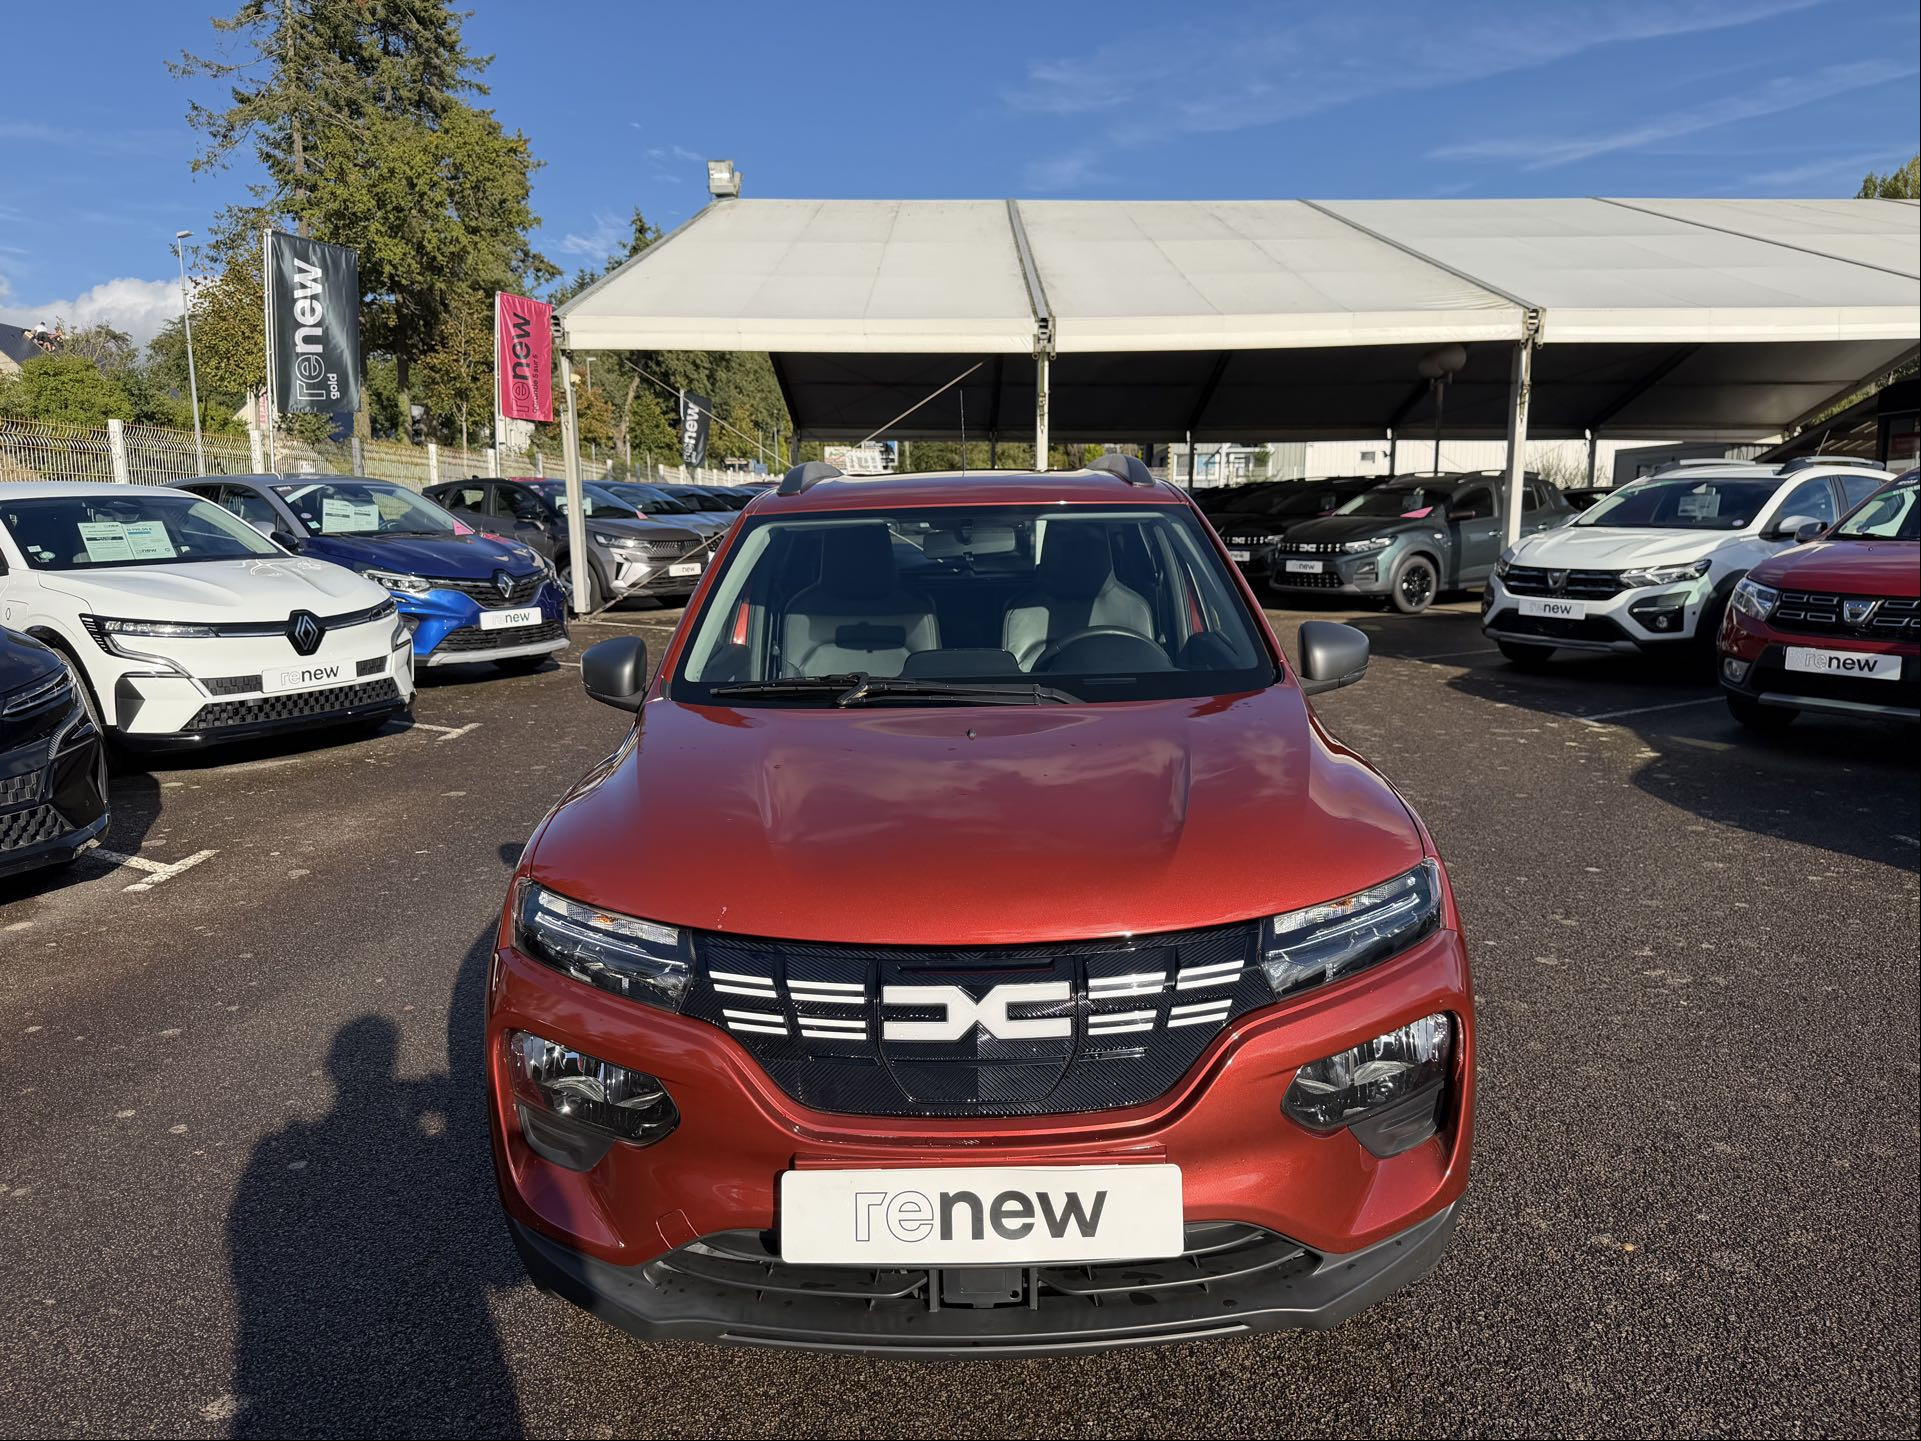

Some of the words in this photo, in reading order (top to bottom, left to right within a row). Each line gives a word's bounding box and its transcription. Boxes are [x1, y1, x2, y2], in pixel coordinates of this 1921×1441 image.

[293, 257, 326, 400] renew
[511, 311, 531, 413] renew
[327, 373, 341, 400] gold
[280, 665, 340, 686] renew
[1804, 653, 1878, 673] renew
[855, 1189, 1108, 1243] renew
